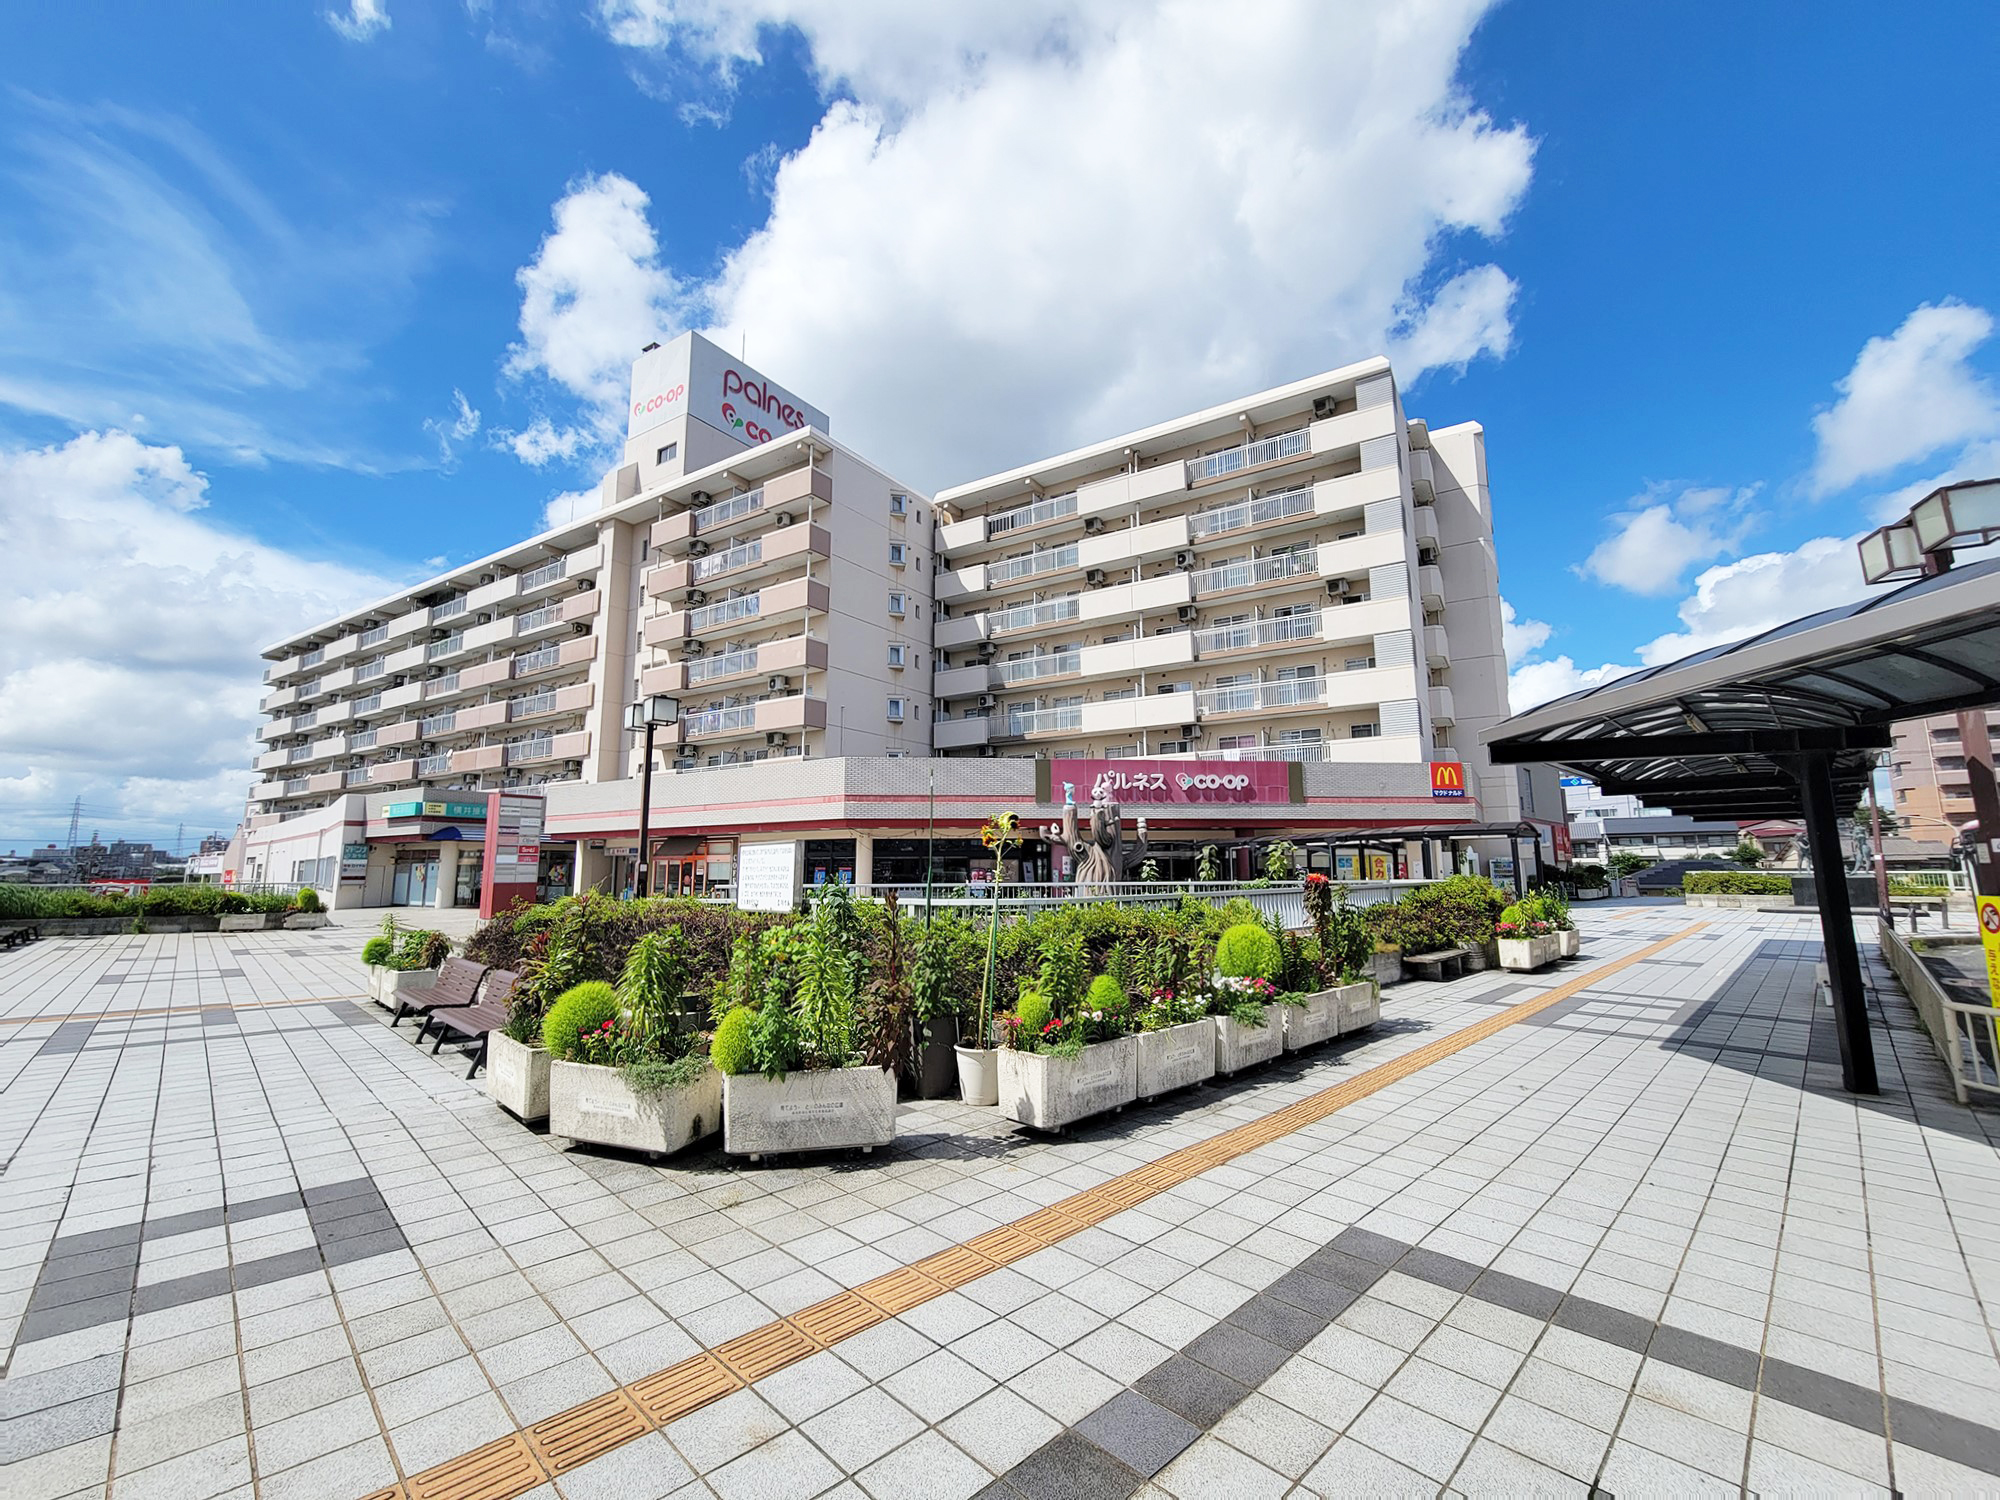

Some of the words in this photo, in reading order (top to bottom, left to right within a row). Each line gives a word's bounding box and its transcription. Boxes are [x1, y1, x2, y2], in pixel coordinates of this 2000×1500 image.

[1095, 770, 1167, 791] パルネス
[1433, 789, 1463, 797] マクドナルド
